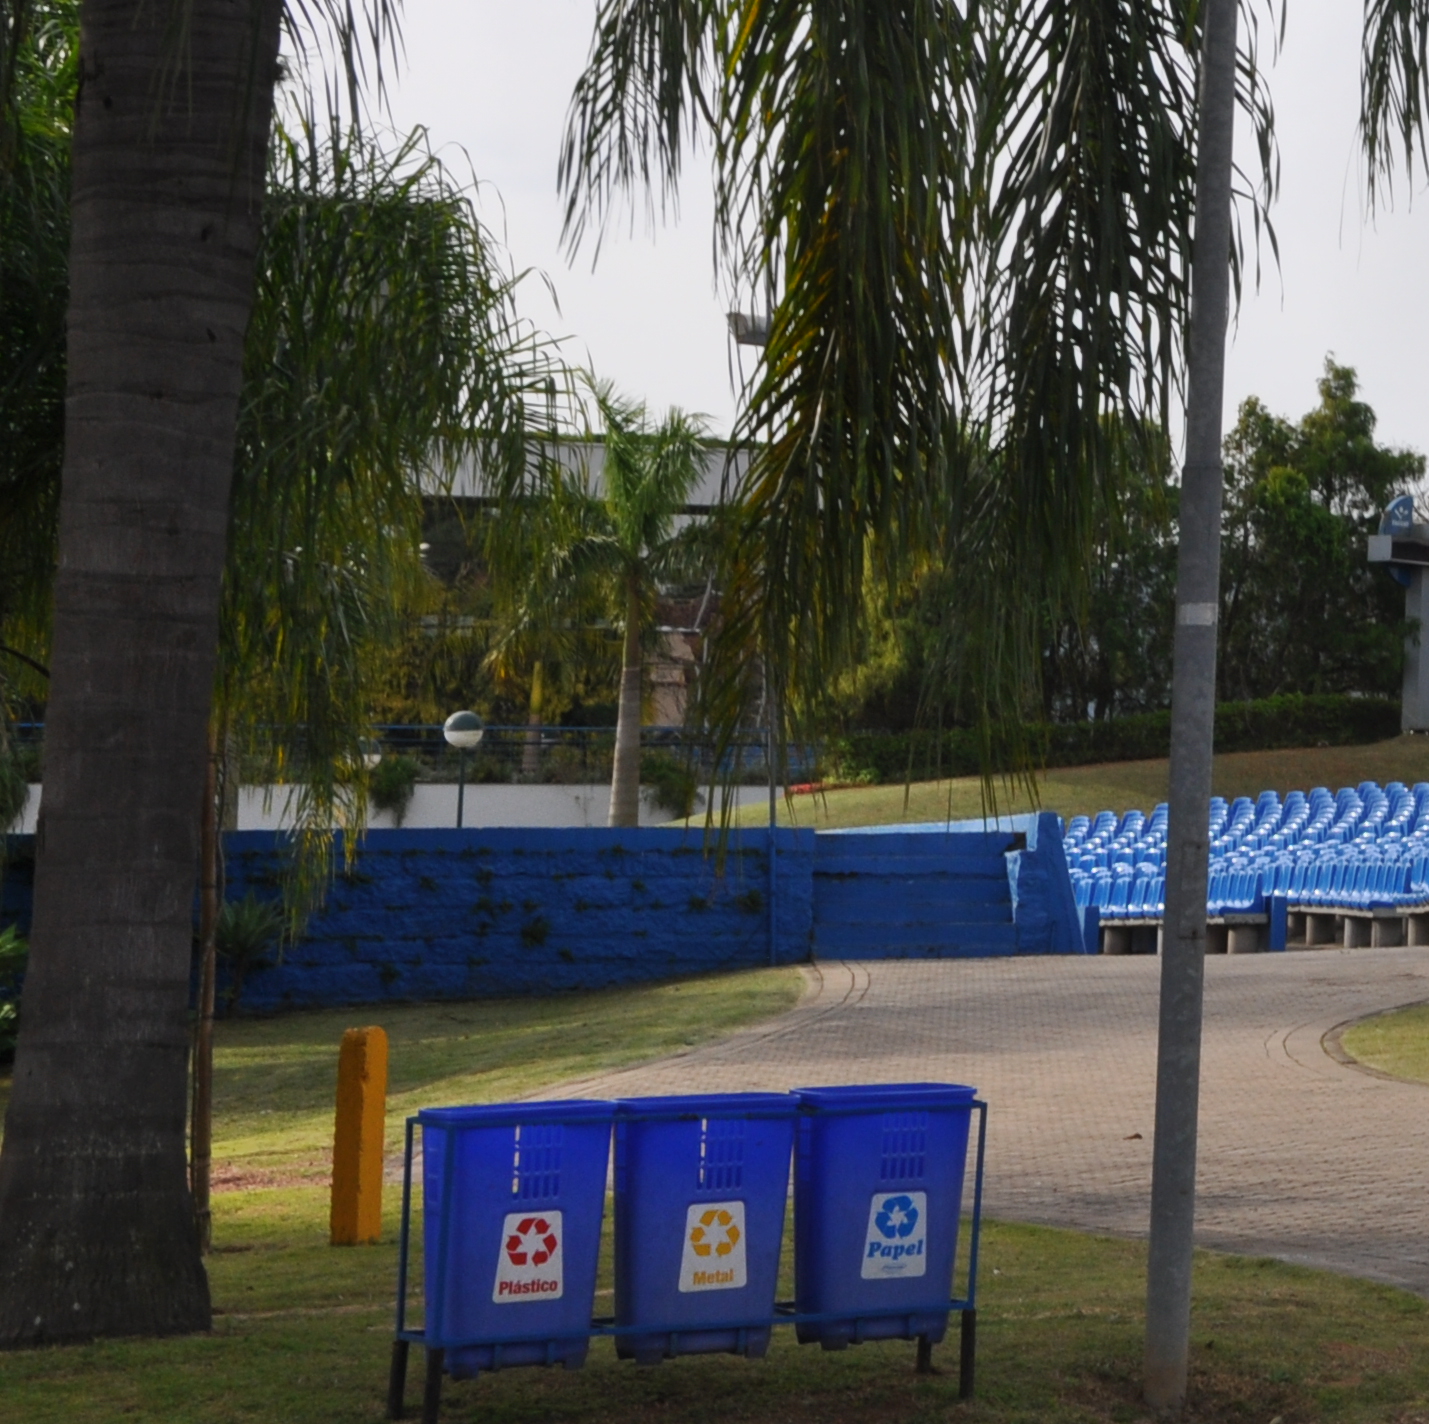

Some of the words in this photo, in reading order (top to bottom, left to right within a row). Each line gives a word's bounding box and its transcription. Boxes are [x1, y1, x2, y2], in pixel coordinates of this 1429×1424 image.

[867, 1239, 923, 1260] Papel
[693, 1268, 734, 1285] Metal
[499, 1279, 558, 1295] Plástico
